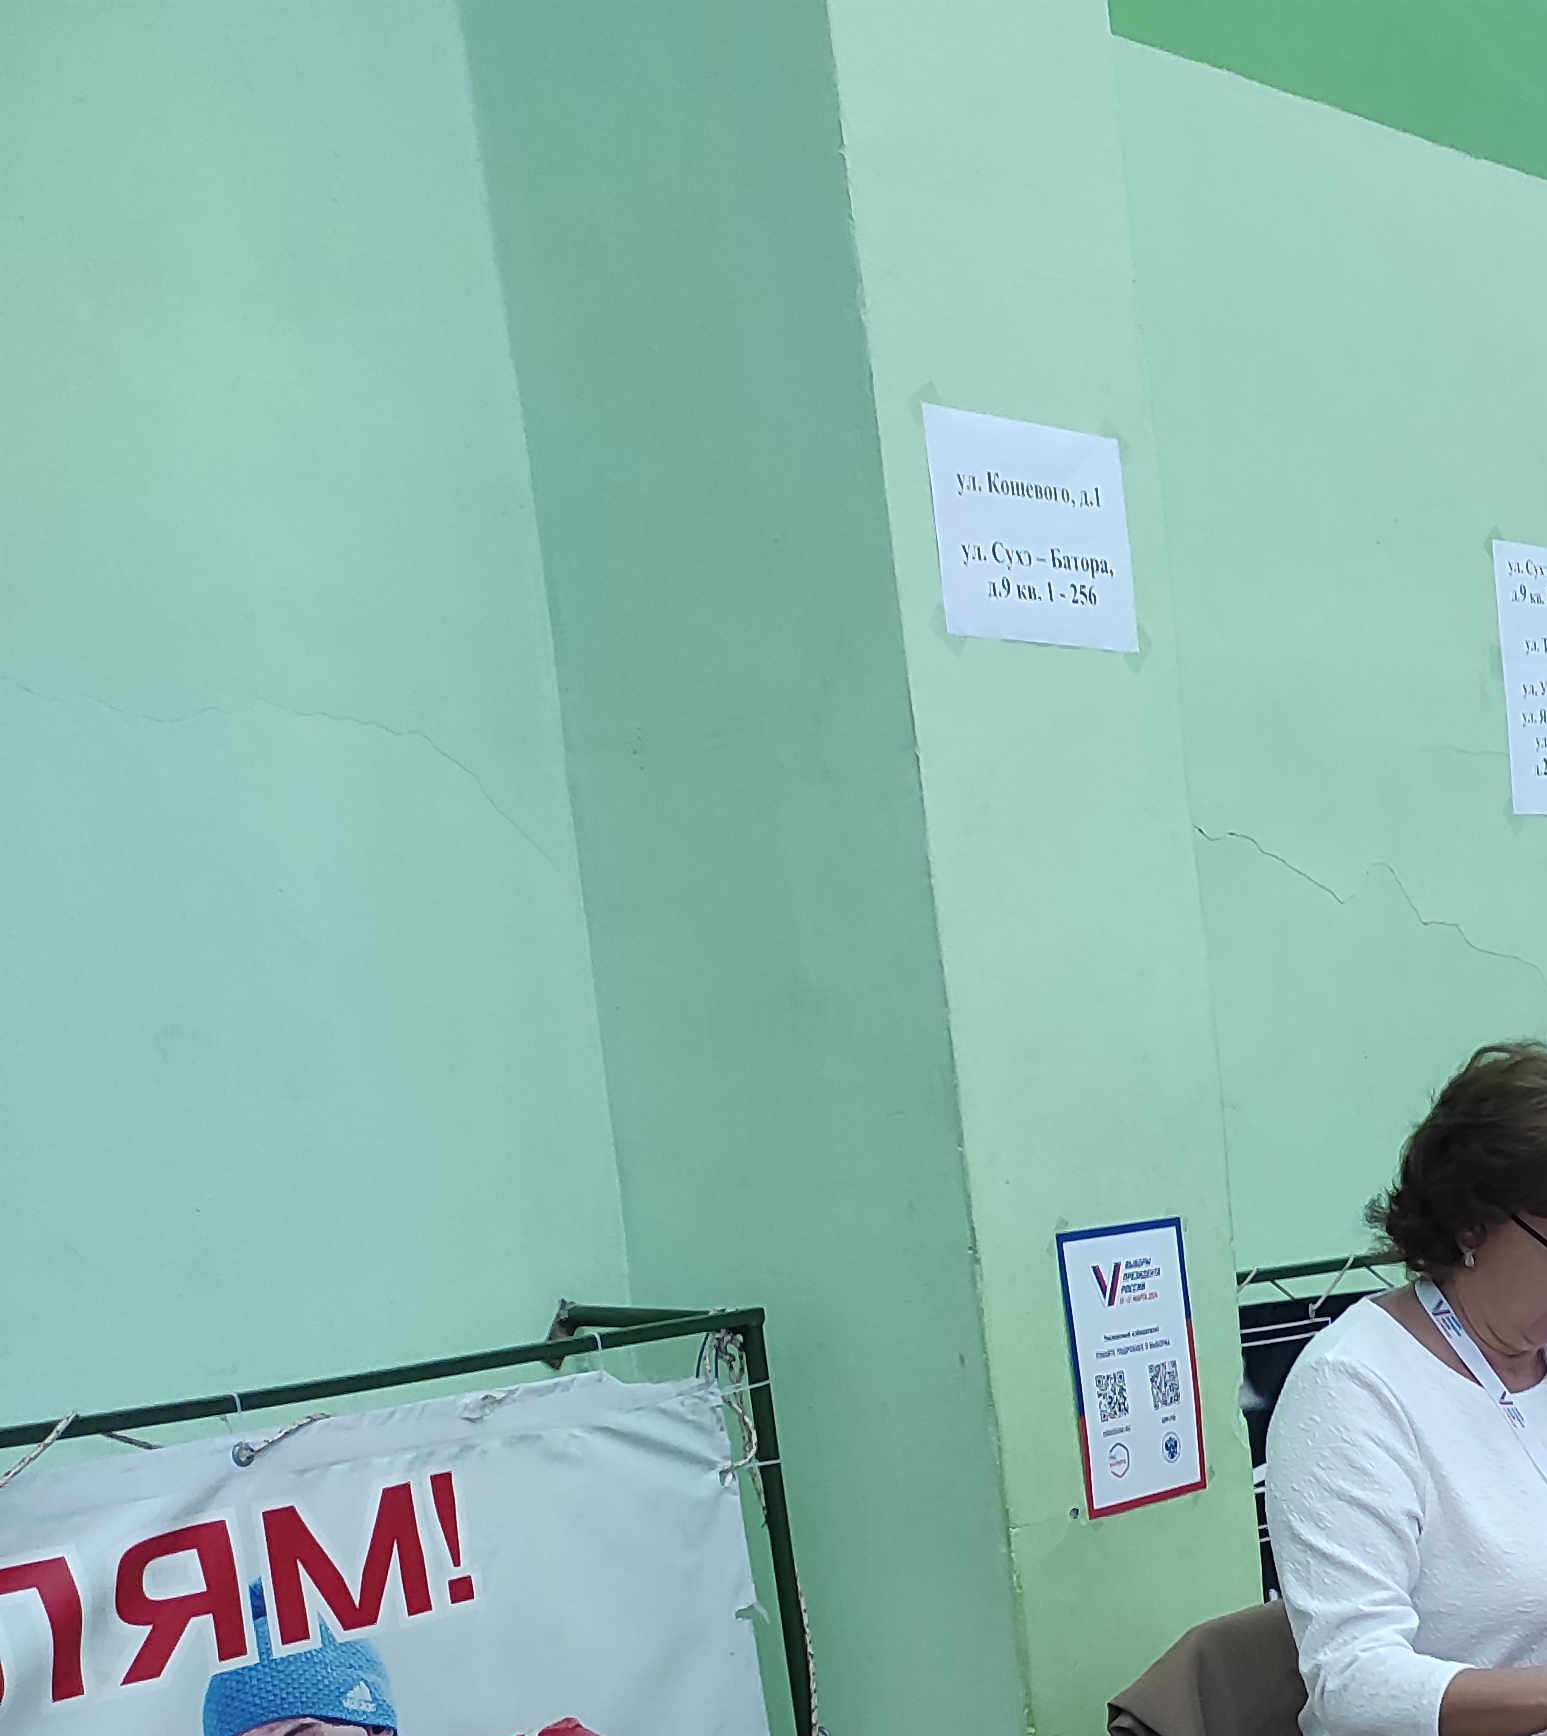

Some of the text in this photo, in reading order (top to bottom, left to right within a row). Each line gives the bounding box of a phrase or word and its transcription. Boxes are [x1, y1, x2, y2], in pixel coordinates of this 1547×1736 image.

[956, 471, 982, 497] ул.
[986, 470, 1077, 508] Кошевого,
[961, 542, 987, 566] ул.
[991, 540, 1033, 571] Сухэ
[1049, 547, 1115, 578] Батора,
[1507, 559, 1524, 577] ул.
[988, 576, 1011, 599] д.9
[1016, 583, 1042, 602] кв.
[1069, 582, 1097, 607] 256
[1524, 638, 1540, 657] ул.
